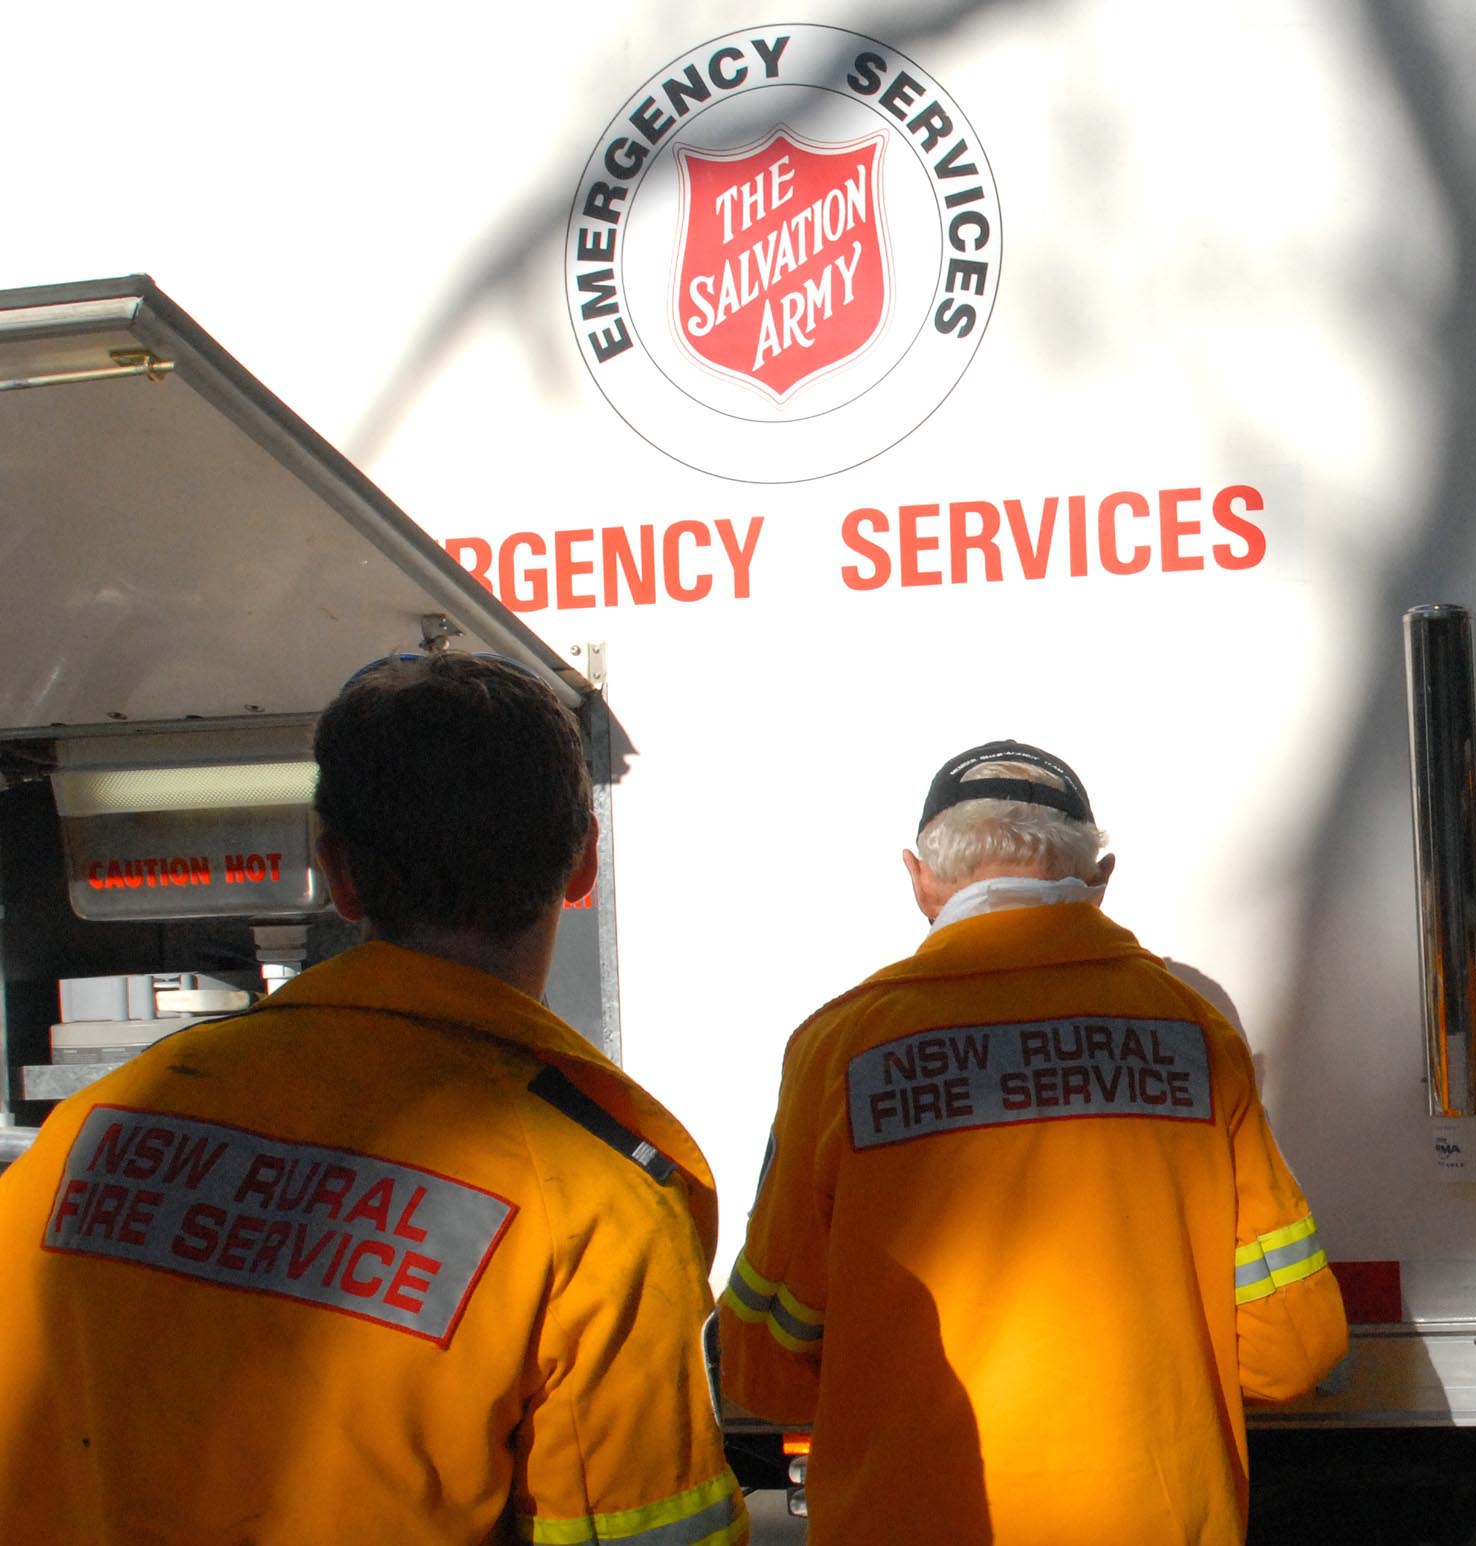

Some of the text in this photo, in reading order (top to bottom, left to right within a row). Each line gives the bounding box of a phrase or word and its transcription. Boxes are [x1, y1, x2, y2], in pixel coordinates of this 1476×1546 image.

[576, 35, 990, 363] EMERGENCY SERVICES
[687, 164, 867, 337] SALVATION
[715, 155, 796, 245] THE
[752, 241, 862, 372] ARMY
[435, 484, 1266, 613] RGENCY SERVICES
[87, 852, 282, 890] CAUTION HOT
[869, 1065, 1194, 1133] FIRE SERVICE
[882, 1023, 1174, 1085] NSW RURAL
[86, 1122, 428, 1243] NSW RURAL
[54, 1179, 442, 1313] FIRE SERVICE
